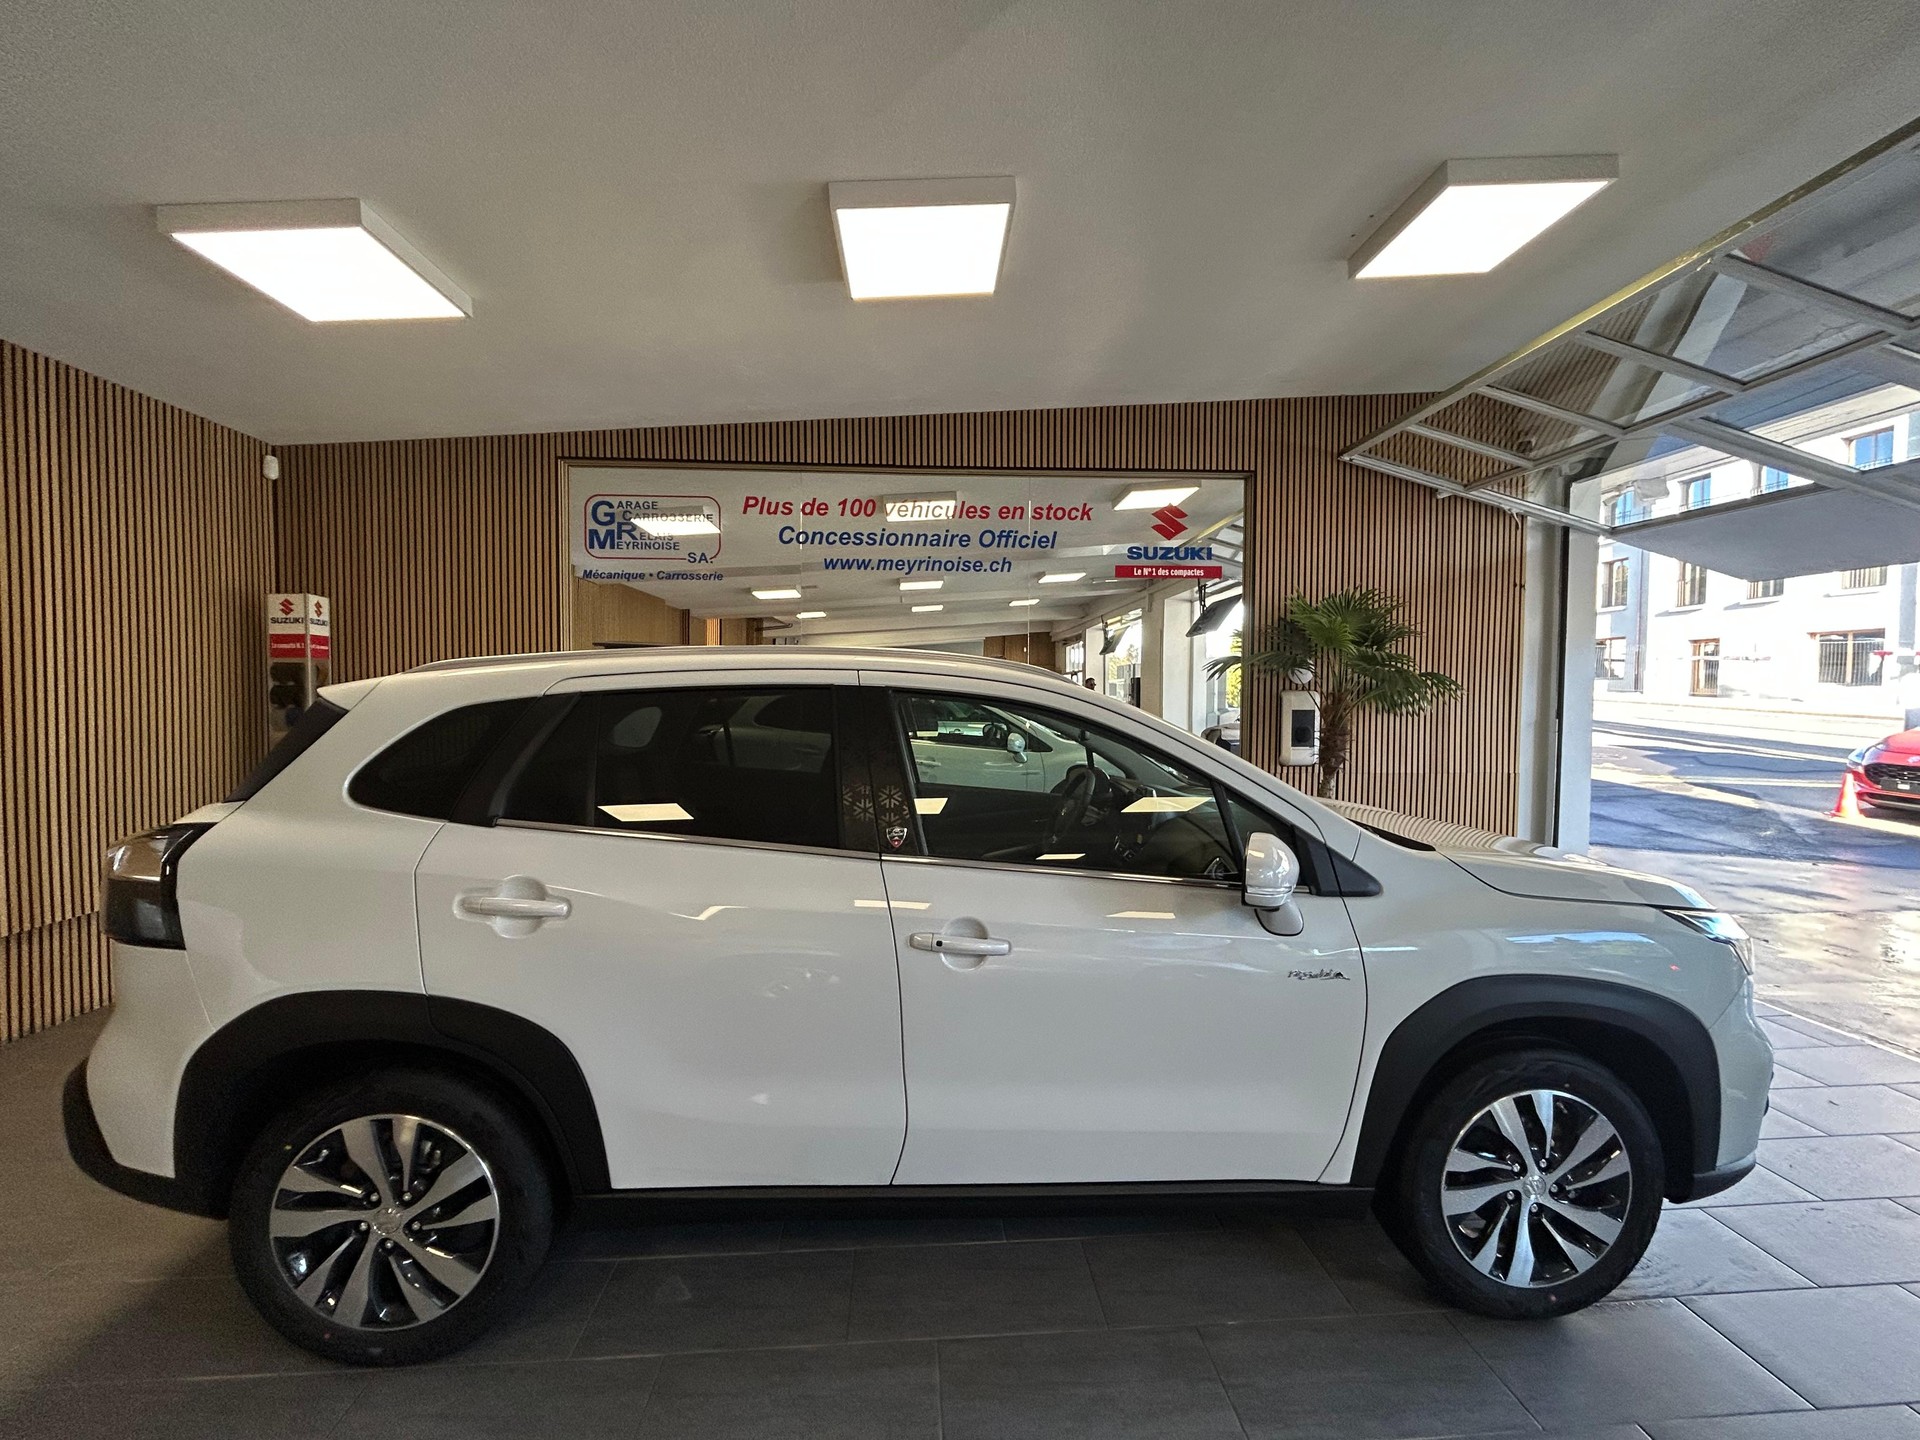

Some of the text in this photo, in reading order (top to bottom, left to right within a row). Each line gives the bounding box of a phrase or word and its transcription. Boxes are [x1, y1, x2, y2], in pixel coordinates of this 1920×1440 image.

[742, 495, 1094, 521] Plus de 100 véhicules en stock
[779, 525, 1058, 550] Concessionnaire Officiel
[1127, 546, 1213, 561] SUZUKI
[824, 556, 1013, 576] www.meyrinoise.ch
[1133, 567, 1142, 576] Le
[1157, 567, 1169, 576] des
[1170, 567, 1205, 577] compactes
[582, 569, 724, 582] Mécanique Carrosserie
